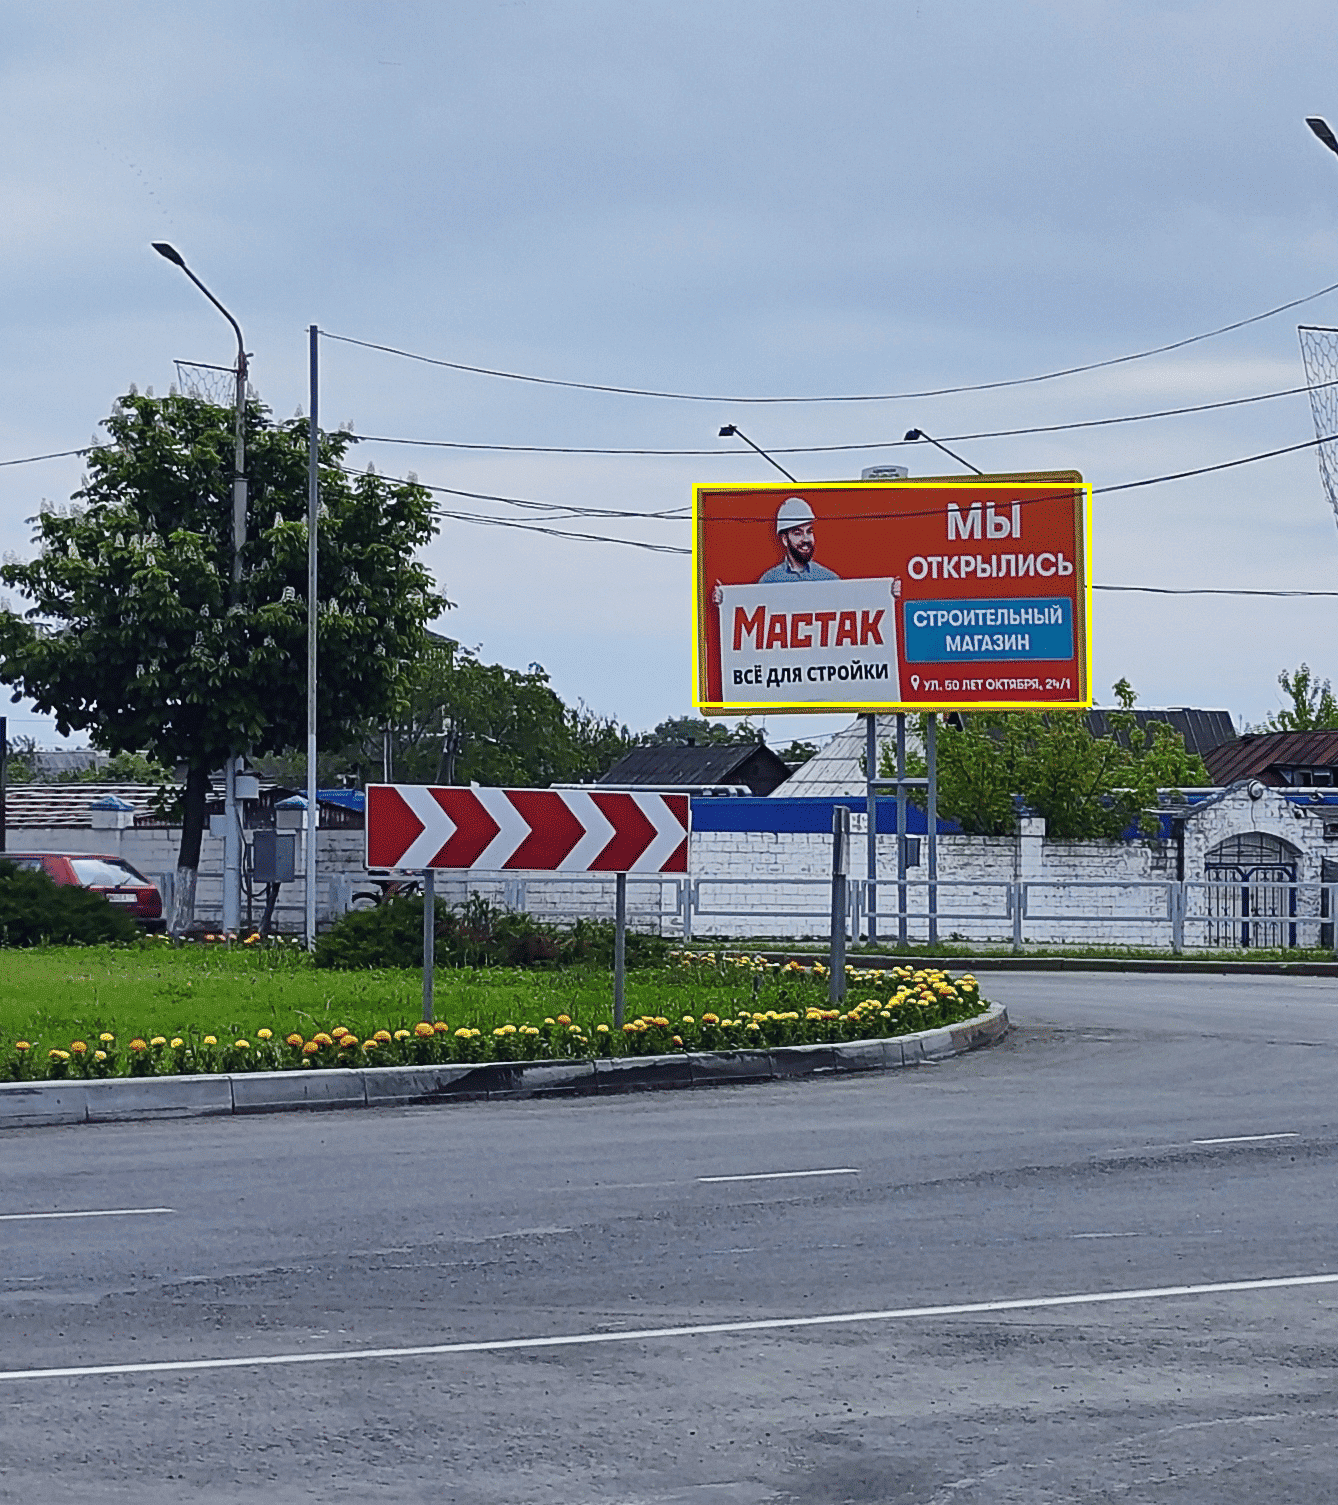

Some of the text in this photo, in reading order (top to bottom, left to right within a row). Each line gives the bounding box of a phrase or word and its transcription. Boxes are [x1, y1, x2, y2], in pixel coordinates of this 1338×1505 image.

[947, 501, 1021, 540] МЫ
[907, 553, 1074, 580] ОТКРЫЛИСЬ
[733, 606, 885, 650] МАСТАК
[913, 605, 1063, 627] СТРОИТЕЛЬНЫЙ
[945, 634, 1030, 652] МАГАЗИН
[733, 660, 889, 688] ВСЁ ДЛЯ СТРОЙКИ
[923, 677, 1071, 691] УЛ. 50 ЛЕТ ОКТЯБРЯ, 24/1
